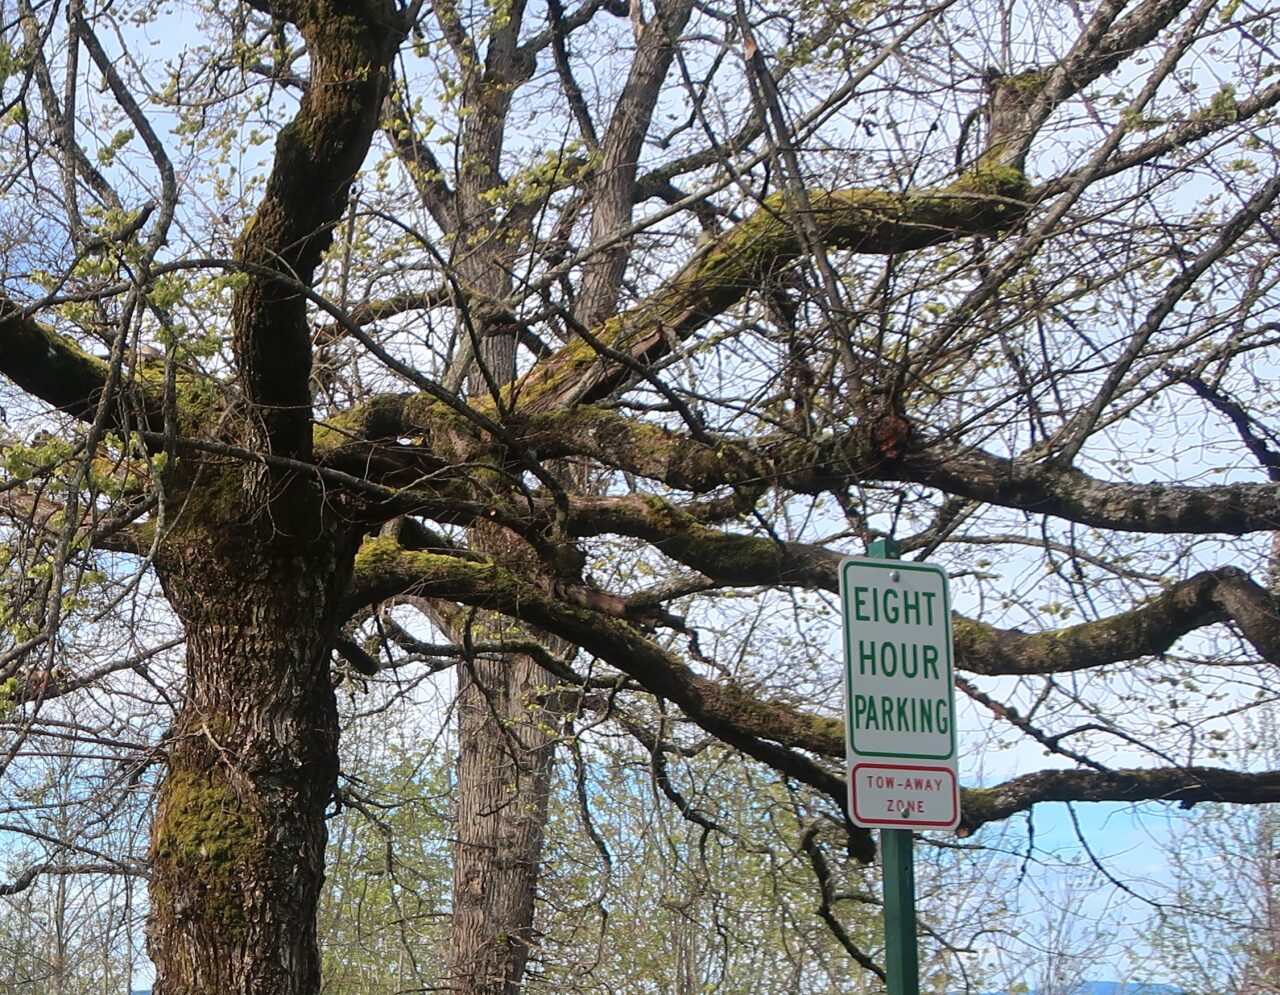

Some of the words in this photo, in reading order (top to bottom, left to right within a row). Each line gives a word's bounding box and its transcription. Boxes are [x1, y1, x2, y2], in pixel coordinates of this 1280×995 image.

[854, 586, 936, 626] EIGHT
[859, 640, 940, 679] HOUR
[855, 694, 948, 735] PARKING
[867, 775, 943, 791] TOW-AWAY
[886, 799, 925, 813] ZONE
